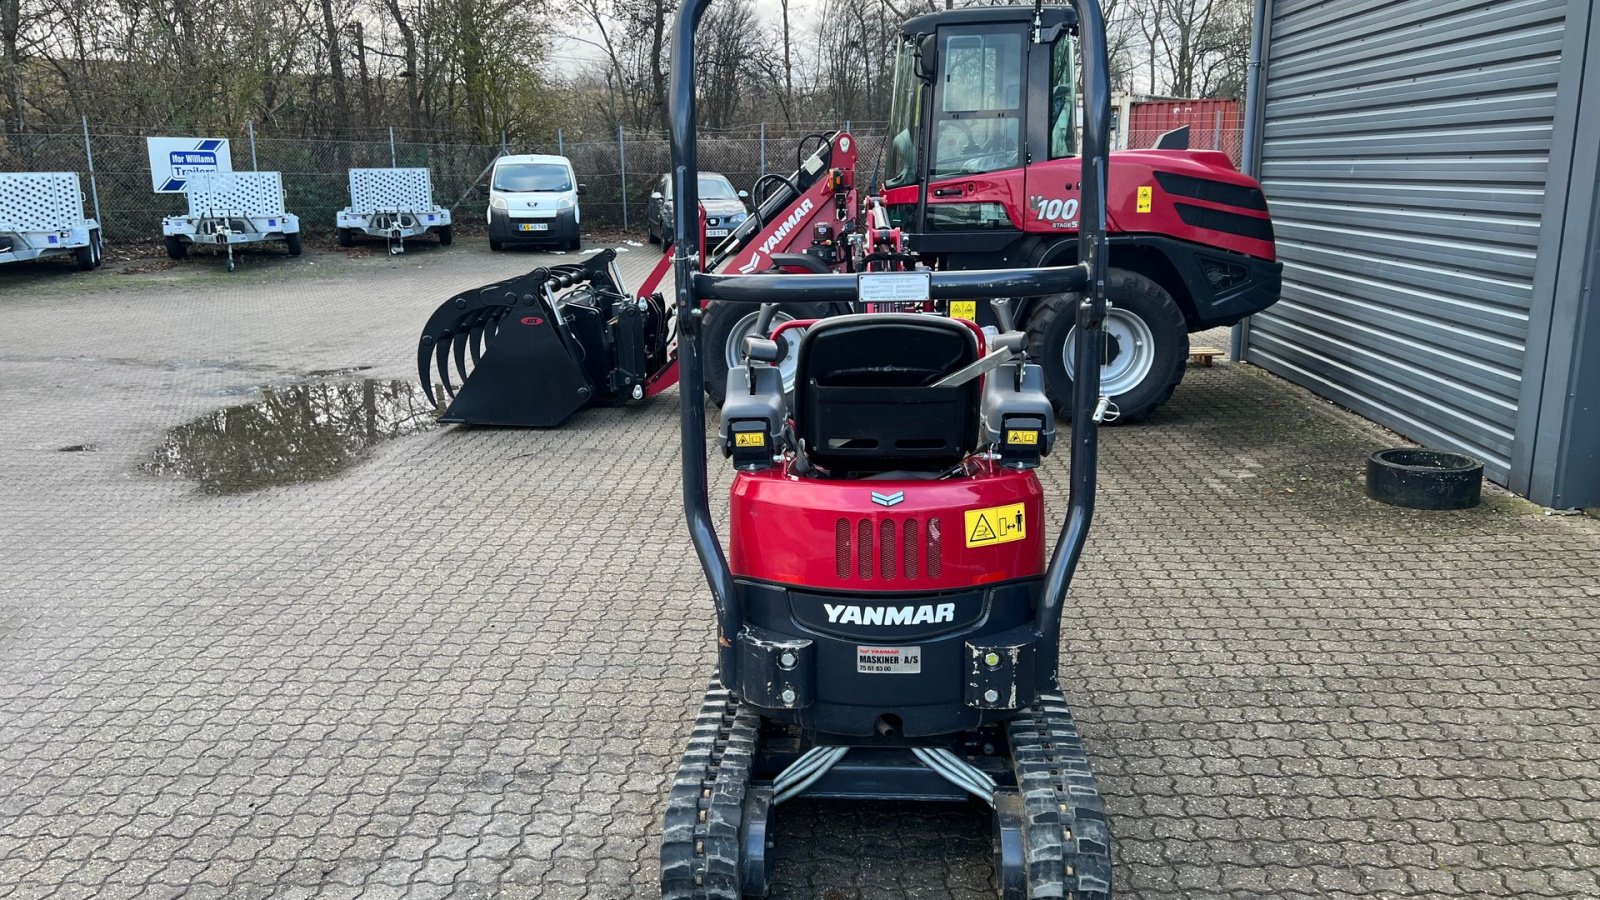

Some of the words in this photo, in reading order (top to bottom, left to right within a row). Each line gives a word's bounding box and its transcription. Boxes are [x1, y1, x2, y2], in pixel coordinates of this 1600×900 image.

[185, 154, 215, 164] Williams
[758, 198, 814, 255] YANMAR
[823, 602, 956, 626] YANMAR
[859, 655, 899, 665] MASKINER
[904, 655, 919, 664] A/S
